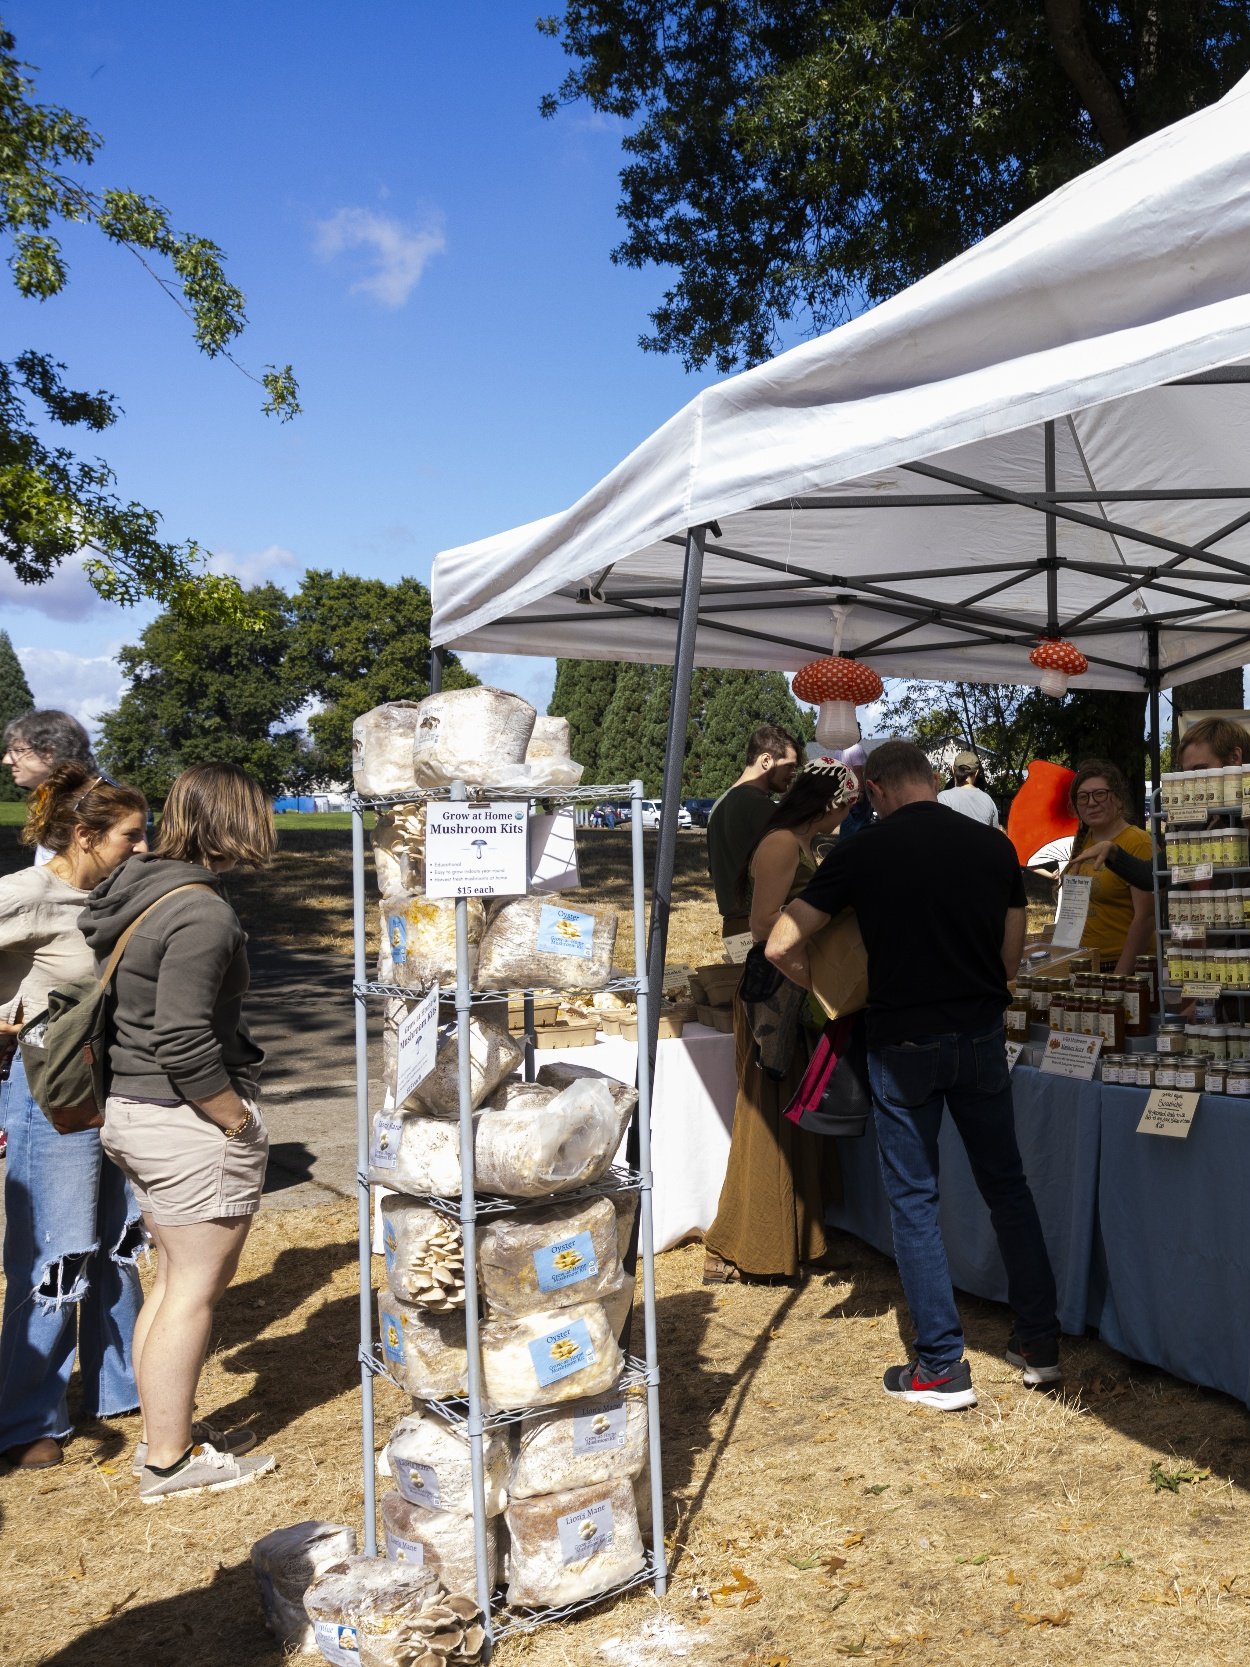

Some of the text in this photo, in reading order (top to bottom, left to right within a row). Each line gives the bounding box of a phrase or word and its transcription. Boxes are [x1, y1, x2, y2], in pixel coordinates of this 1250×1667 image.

[442, 812, 513, 821] Grow at Home
[430, 824, 523, 834] Mushroom Kits
[457, 886, 495, 895] $15 each
[558, 910, 580, 921] Oyster
[400, 1008, 437, 1050] Mushroom Kits
[552, 1240, 576, 1253] Oyster
[546, 1329, 571, 1343] Oyster
[587, 1505, 606, 1517] Mane
